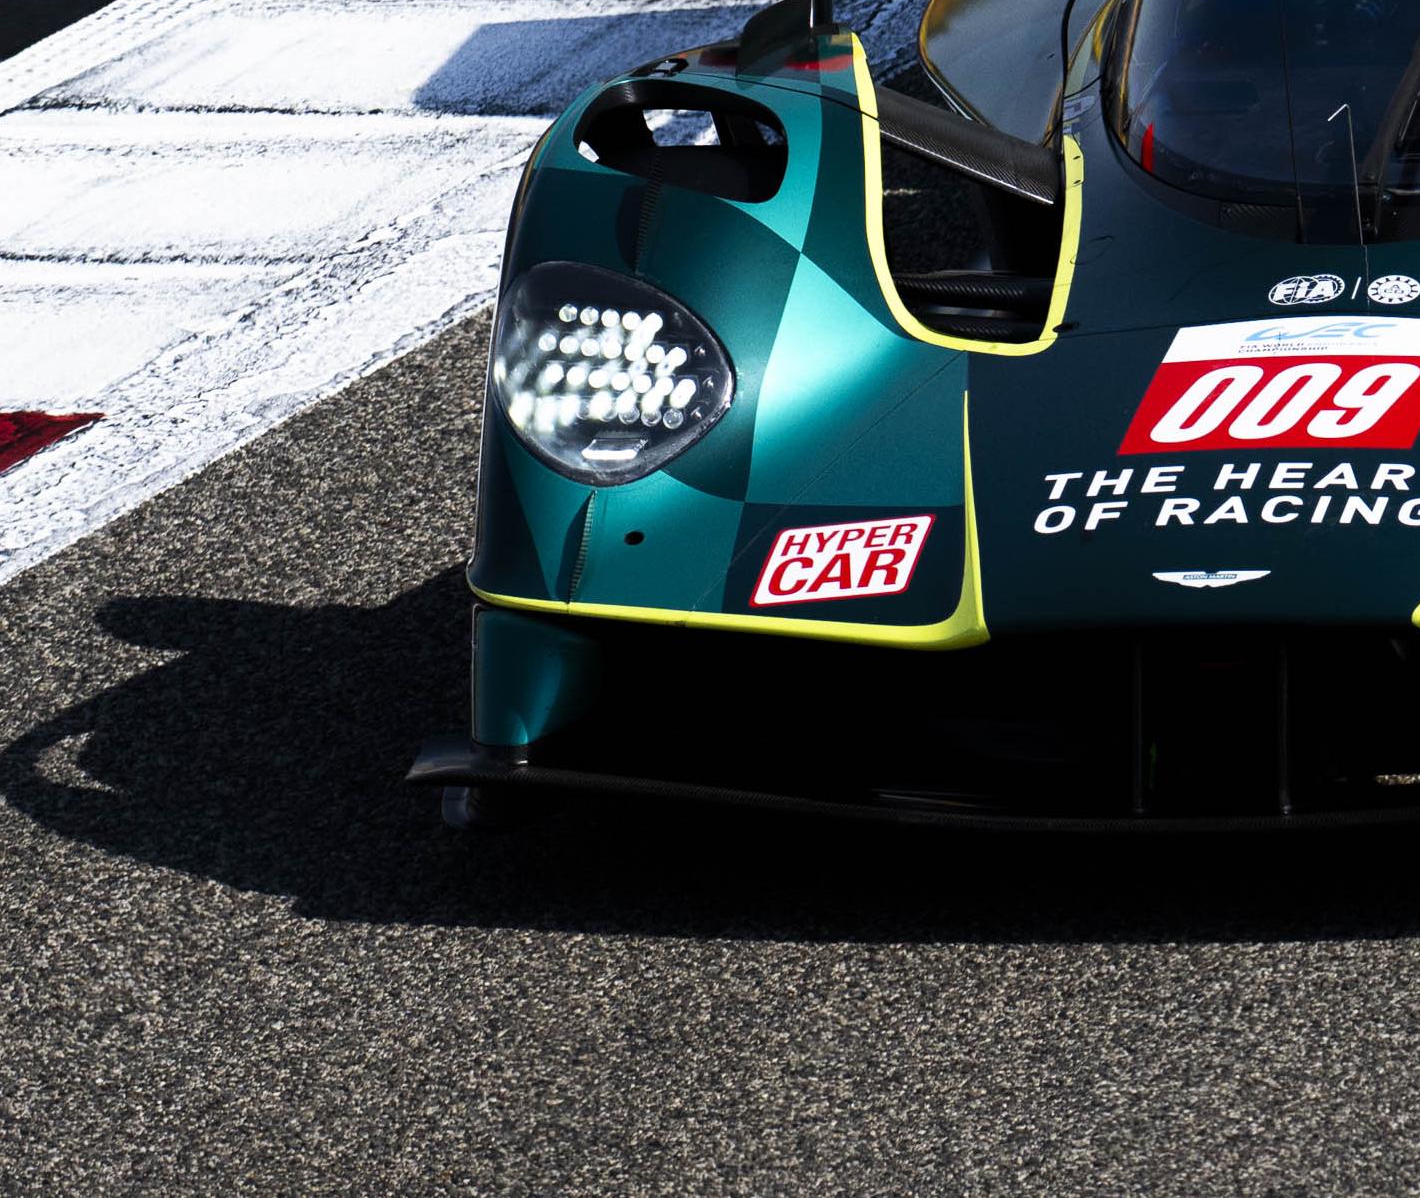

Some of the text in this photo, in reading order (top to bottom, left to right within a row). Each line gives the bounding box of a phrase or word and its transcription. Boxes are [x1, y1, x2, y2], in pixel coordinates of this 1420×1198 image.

[1244, 322, 1398, 342] WEC
[1150, 362, 1420, 443] 009
[1044, 465, 1185, 500] THE
[1033, 501, 1129, 534] OF
[780, 523, 919, 557] HYPER
[768, 548, 906, 596] CAR
